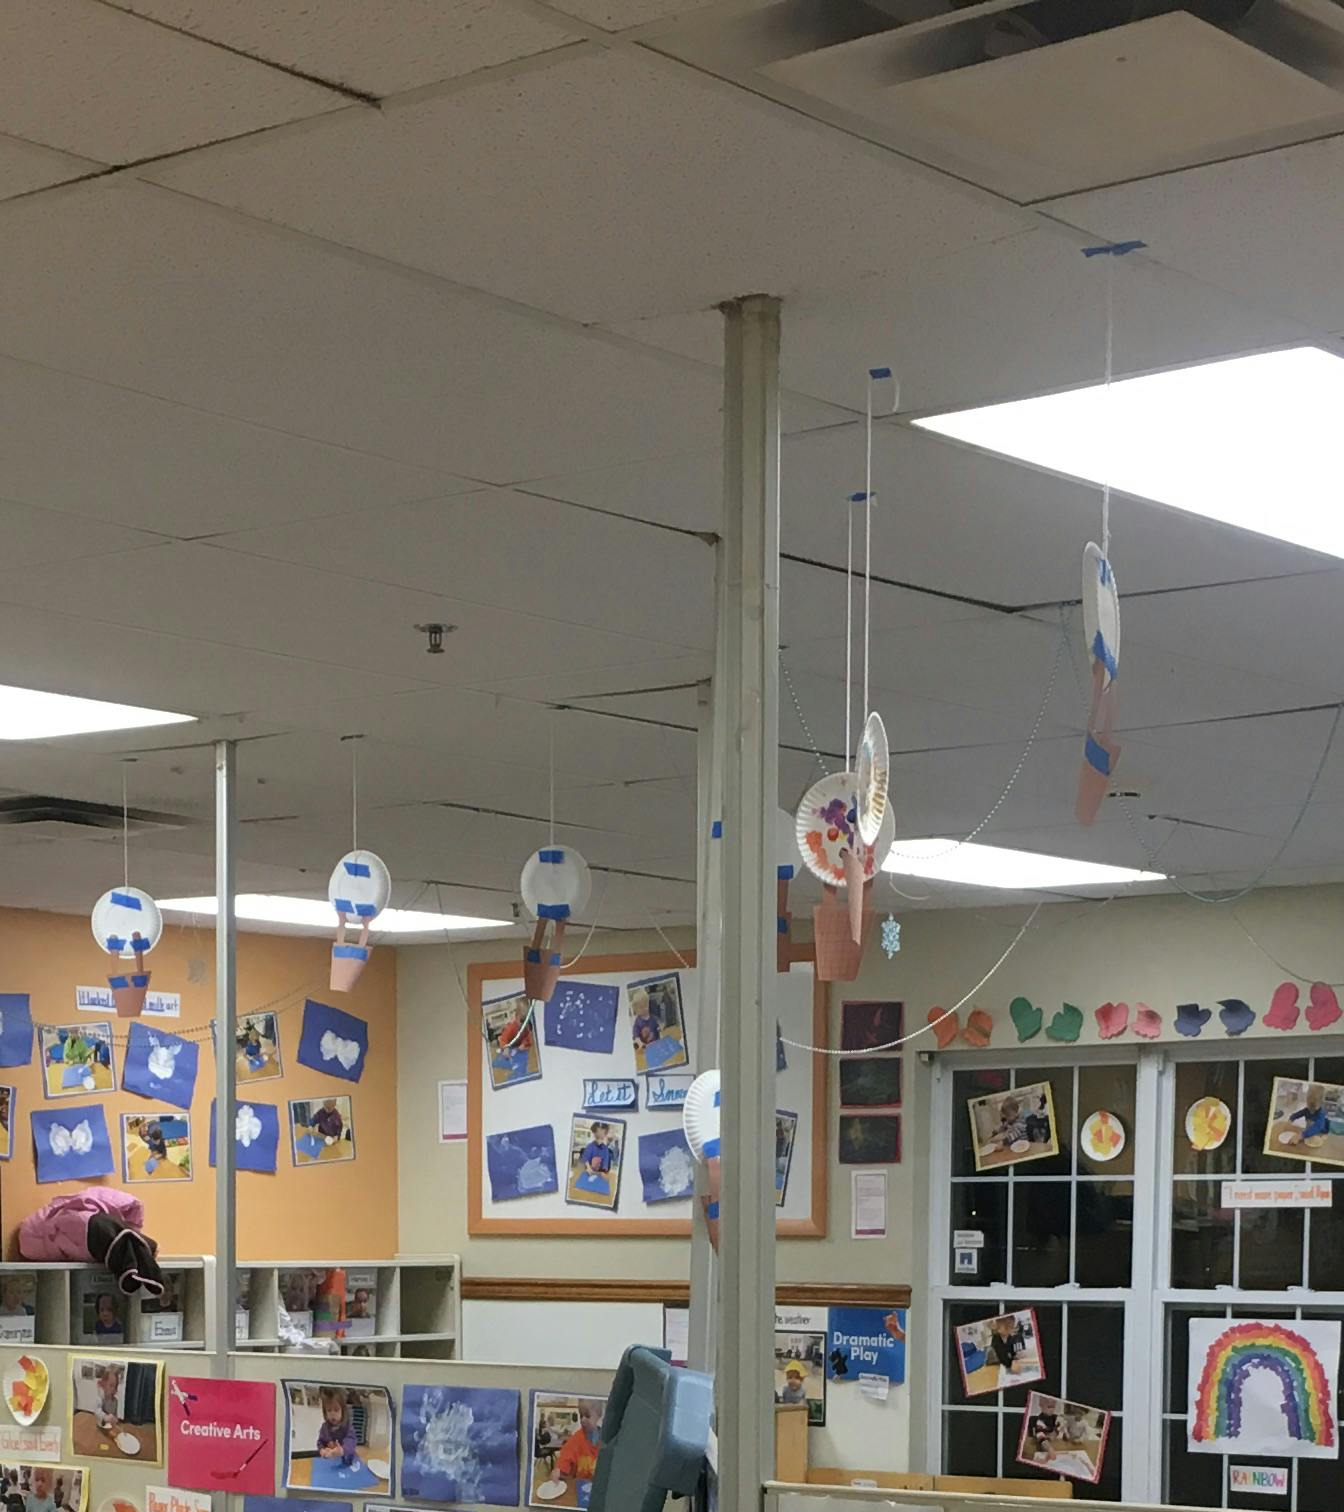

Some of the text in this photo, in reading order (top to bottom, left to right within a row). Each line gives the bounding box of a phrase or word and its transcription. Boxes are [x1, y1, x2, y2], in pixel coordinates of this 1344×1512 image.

[587, 1079, 613, 1104] Let
[833, 1332, 895, 1348] Dramatic
[850, 1347, 878, 1365] Play
[180, 1420, 261, 1441] Creative Arts
